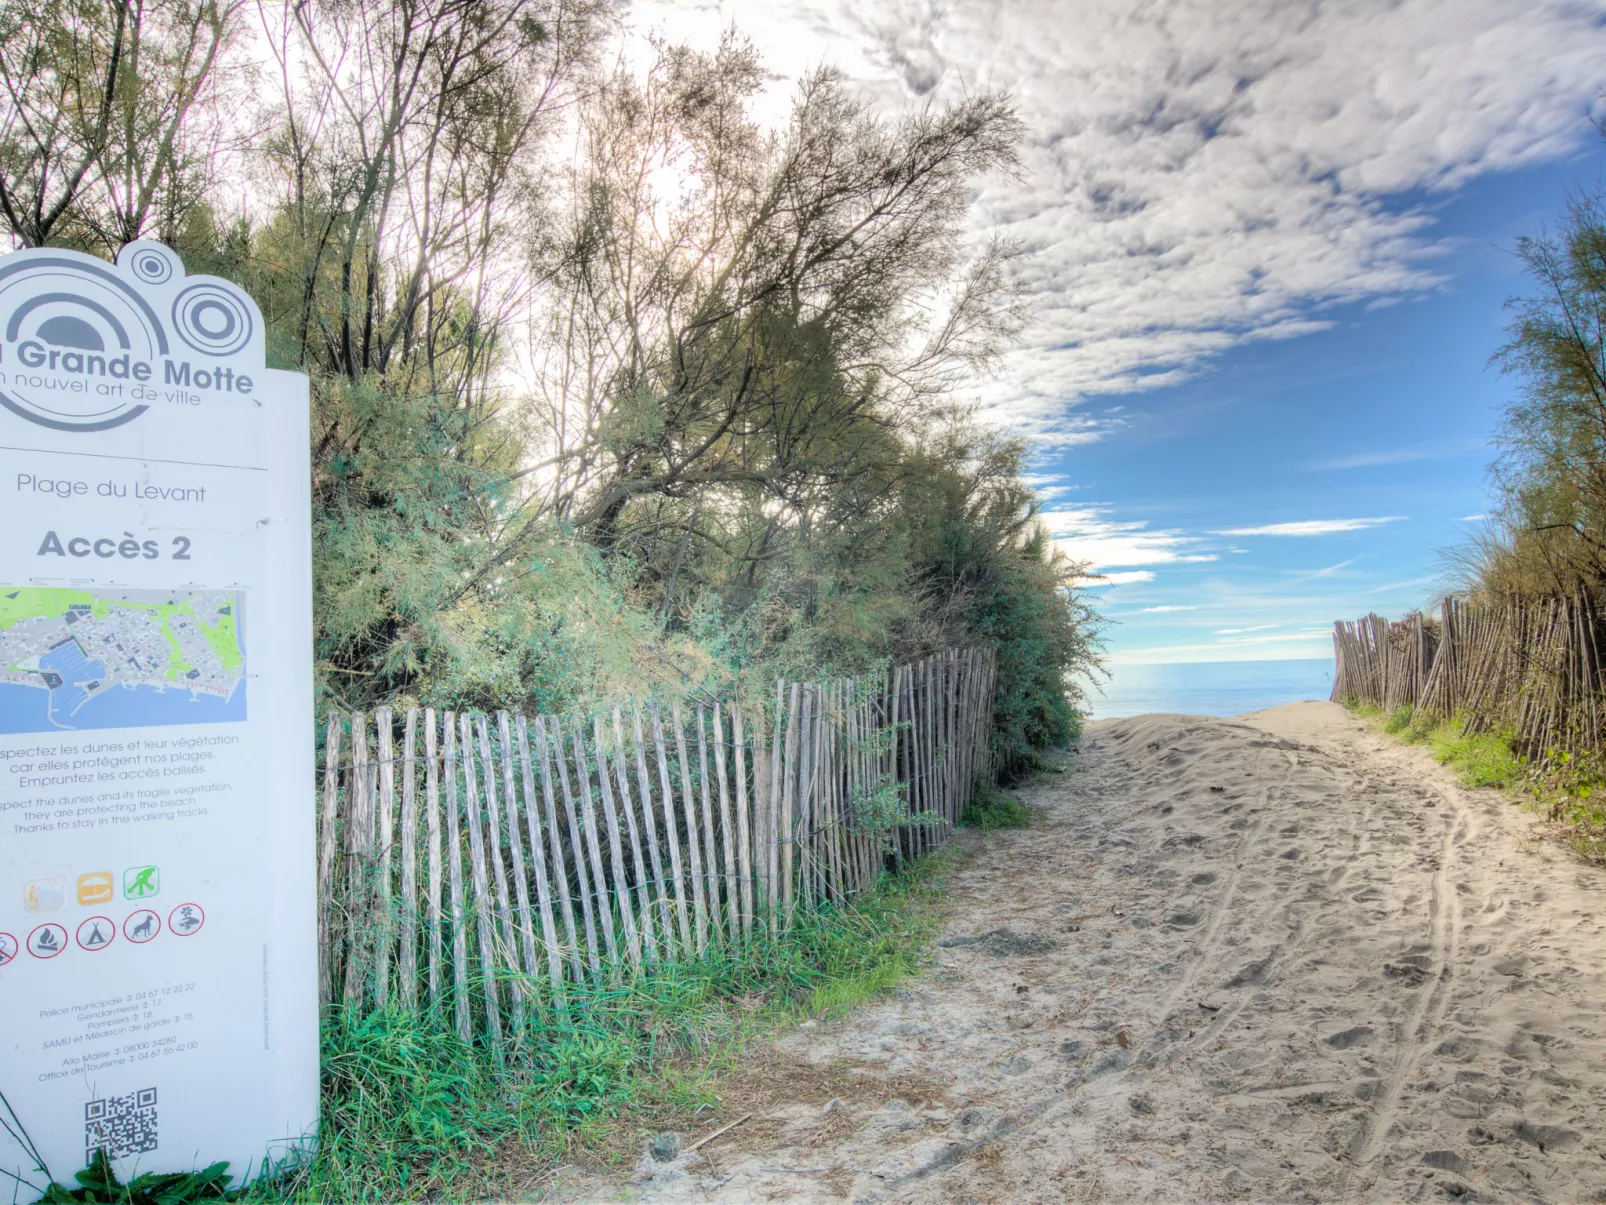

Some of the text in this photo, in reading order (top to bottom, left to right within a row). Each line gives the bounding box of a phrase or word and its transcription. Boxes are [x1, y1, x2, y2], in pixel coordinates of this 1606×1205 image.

[17, 341, 152, 381] Grande
[164, 360, 253, 394] Motte
[15, 374, 88, 393] nouvel
[96, 383, 124, 397] art
[131, 384, 158, 401] de
[164, 390, 201, 406] ville
[17, 474, 206, 502] Plage du Levant
[36, 531, 191, 560] Accès 2
[60, 744, 78, 755] les
[82, 743, 124, 754] dunes
[127, 740, 140, 750] et
[145, 740, 168, 749] leur
[171, 735, 239, 749] végétation
[9, 764, 34, 773] car
[38, 760, 69, 771] elles
[145, 754, 167, 764] nos
[20, 764, 208, 788] Empruntez les accès balisés.
[36, 797, 55, 807] the
[58, 795, 94, 805] dunes
[97, 792, 120, 802] and
[123, 790, 135, 799] its
[137, 787, 170, 798] fragile
[14, 823, 54, 834] Thanks
[57, 821, 69, 829] to
[72, 819, 96, 829] stay
[98, 817, 108, 825] in
[112, 815, 130, 824] the
[133, 811, 174, 822] walking
[24, 811, 50, 821] they
[54, 809, 74, 818] are
[77, 803, 136, 816] protecting
[140, 801, 157, 809] the
[40, 982, 196, 1018] Police municipale 04 67 12 22 22
[77, 999, 162, 1022] Gendarmerie 17
[87, 1010, 152, 1030] Pompiers 18
[43, 1038, 71, 1049] SAMU
[73, 1035, 83, 1043] et
[85, 1027, 127, 1041] Médecin
[129, 1024, 141, 1032] de
[143, 1018, 171, 1030] garde
[38, 1070, 69, 1082] Office
[70, 1066, 84, 1076] de
[86, 1058, 126, 1072] Tourisme
[187, 1041, 198, 1050] 00
[82, 1051, 110, 1062] Mairie
